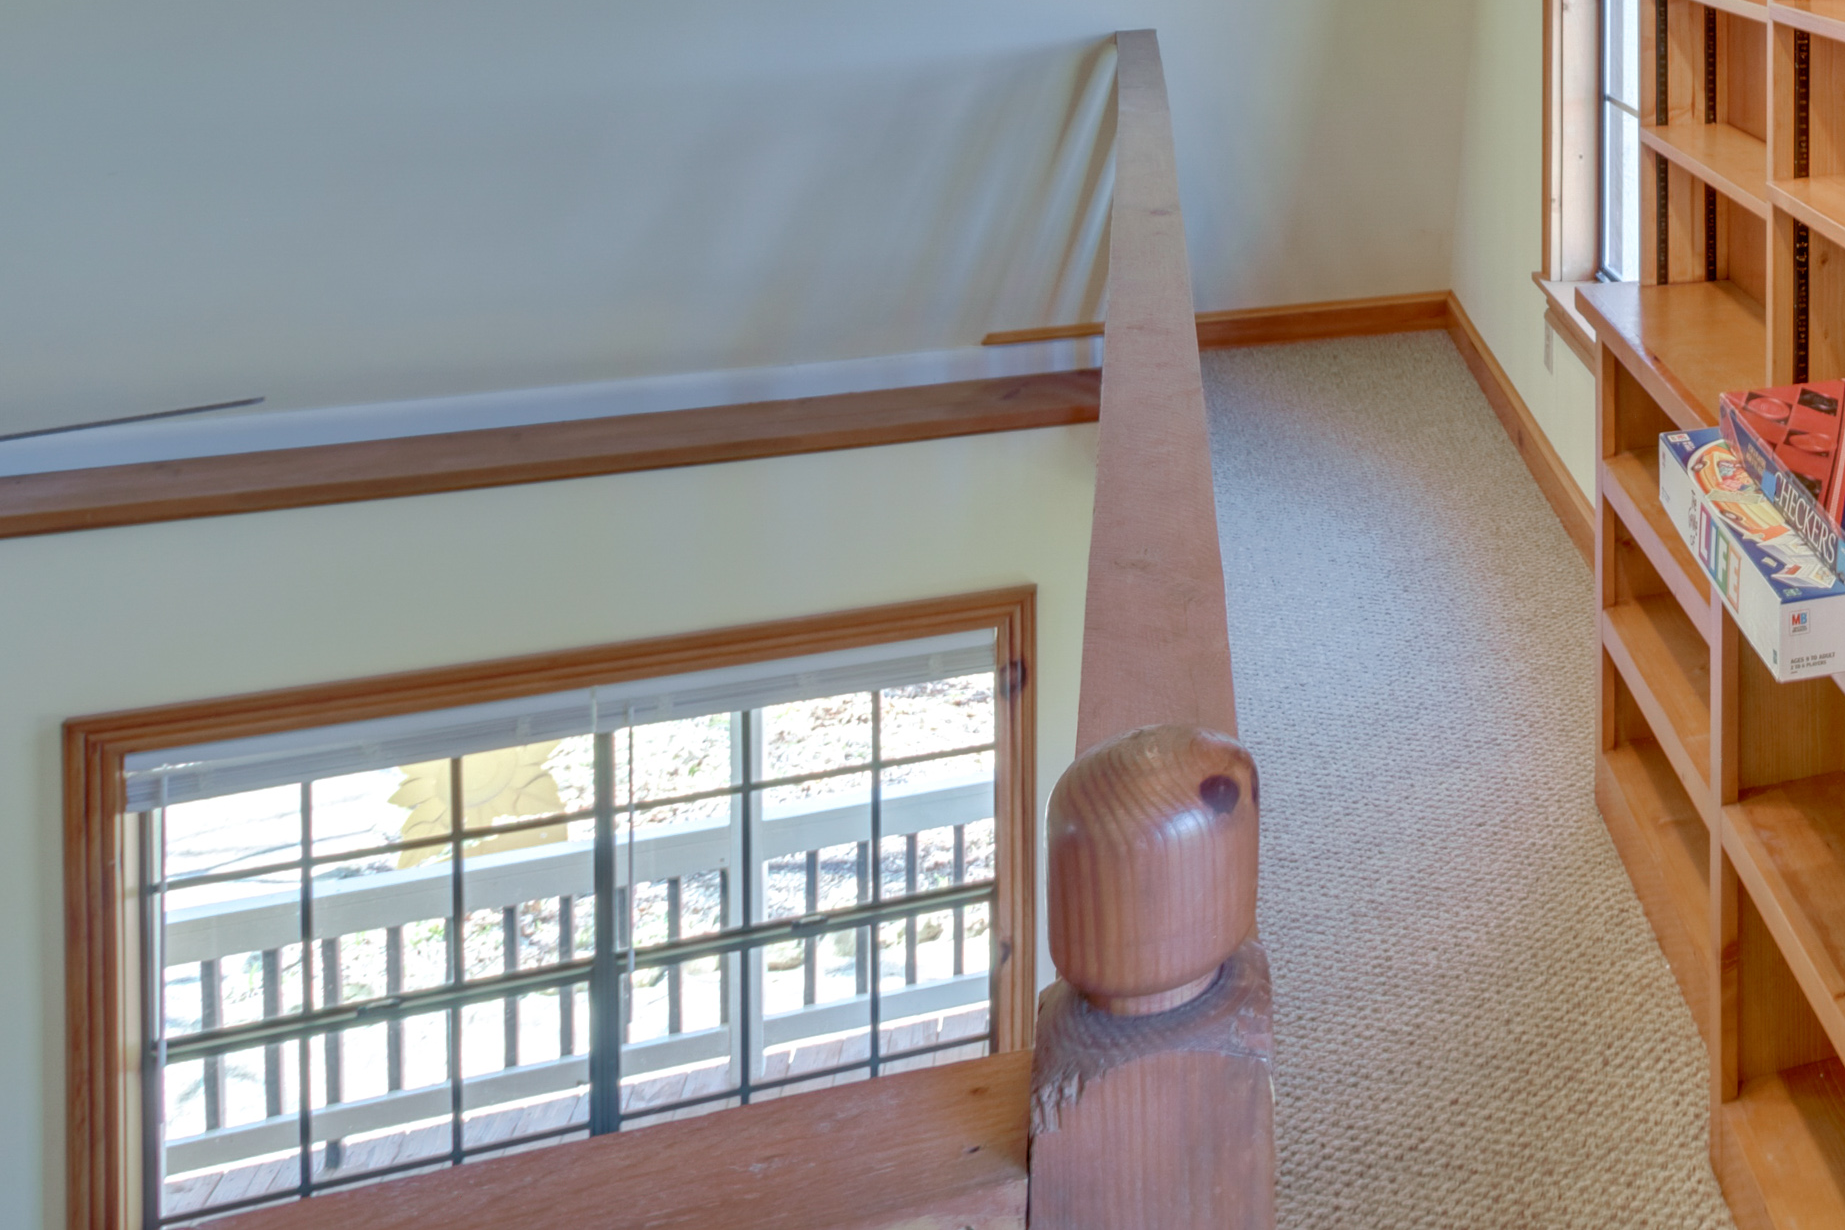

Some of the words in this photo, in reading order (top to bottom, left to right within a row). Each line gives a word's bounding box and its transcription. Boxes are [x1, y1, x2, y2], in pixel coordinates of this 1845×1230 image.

[1774, 471, 1838, 564] CHECKERS
[1702, 506, 1741, 613] LIFE
[1792, 612, 1808, 626] MB
[1790, 656, 1805, 664] AGES
[1819, 651, 1836, 660] ADULT
[1806, 659, 1827, 668] PLAYERS
